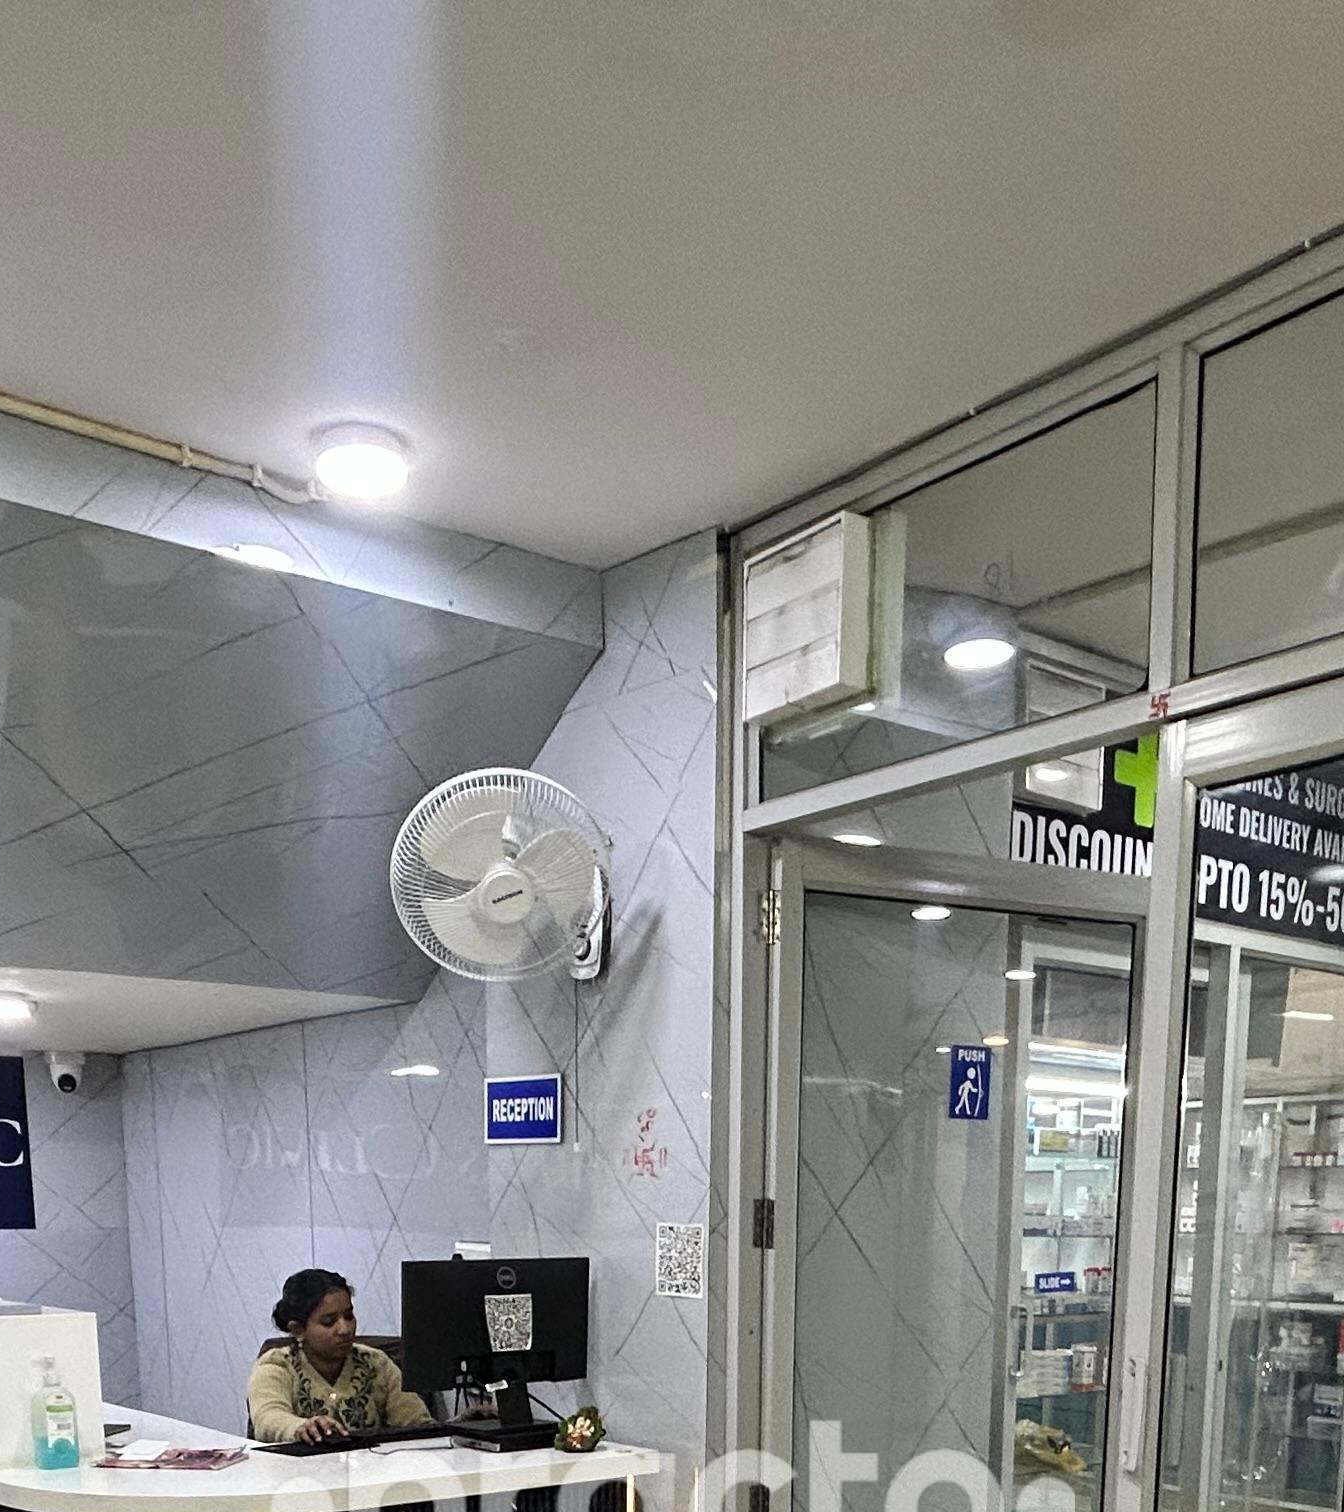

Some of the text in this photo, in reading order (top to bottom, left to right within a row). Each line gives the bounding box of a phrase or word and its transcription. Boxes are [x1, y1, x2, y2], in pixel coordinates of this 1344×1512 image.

[1288, 772, 1300, 805] &
[1199, 796, 1235, 834] OME
[1238, 806, 1312, 854] DELIVERY
[1010, 809, 1154, 878] DISCOUN
[1197, 854, 1252, 914] PTO
[958, 1048, 986, 1062] PUSH
[492, 1096, 554, 1123] RECEPTION
[1038, 1277, 1060, 1290] SLIDE
